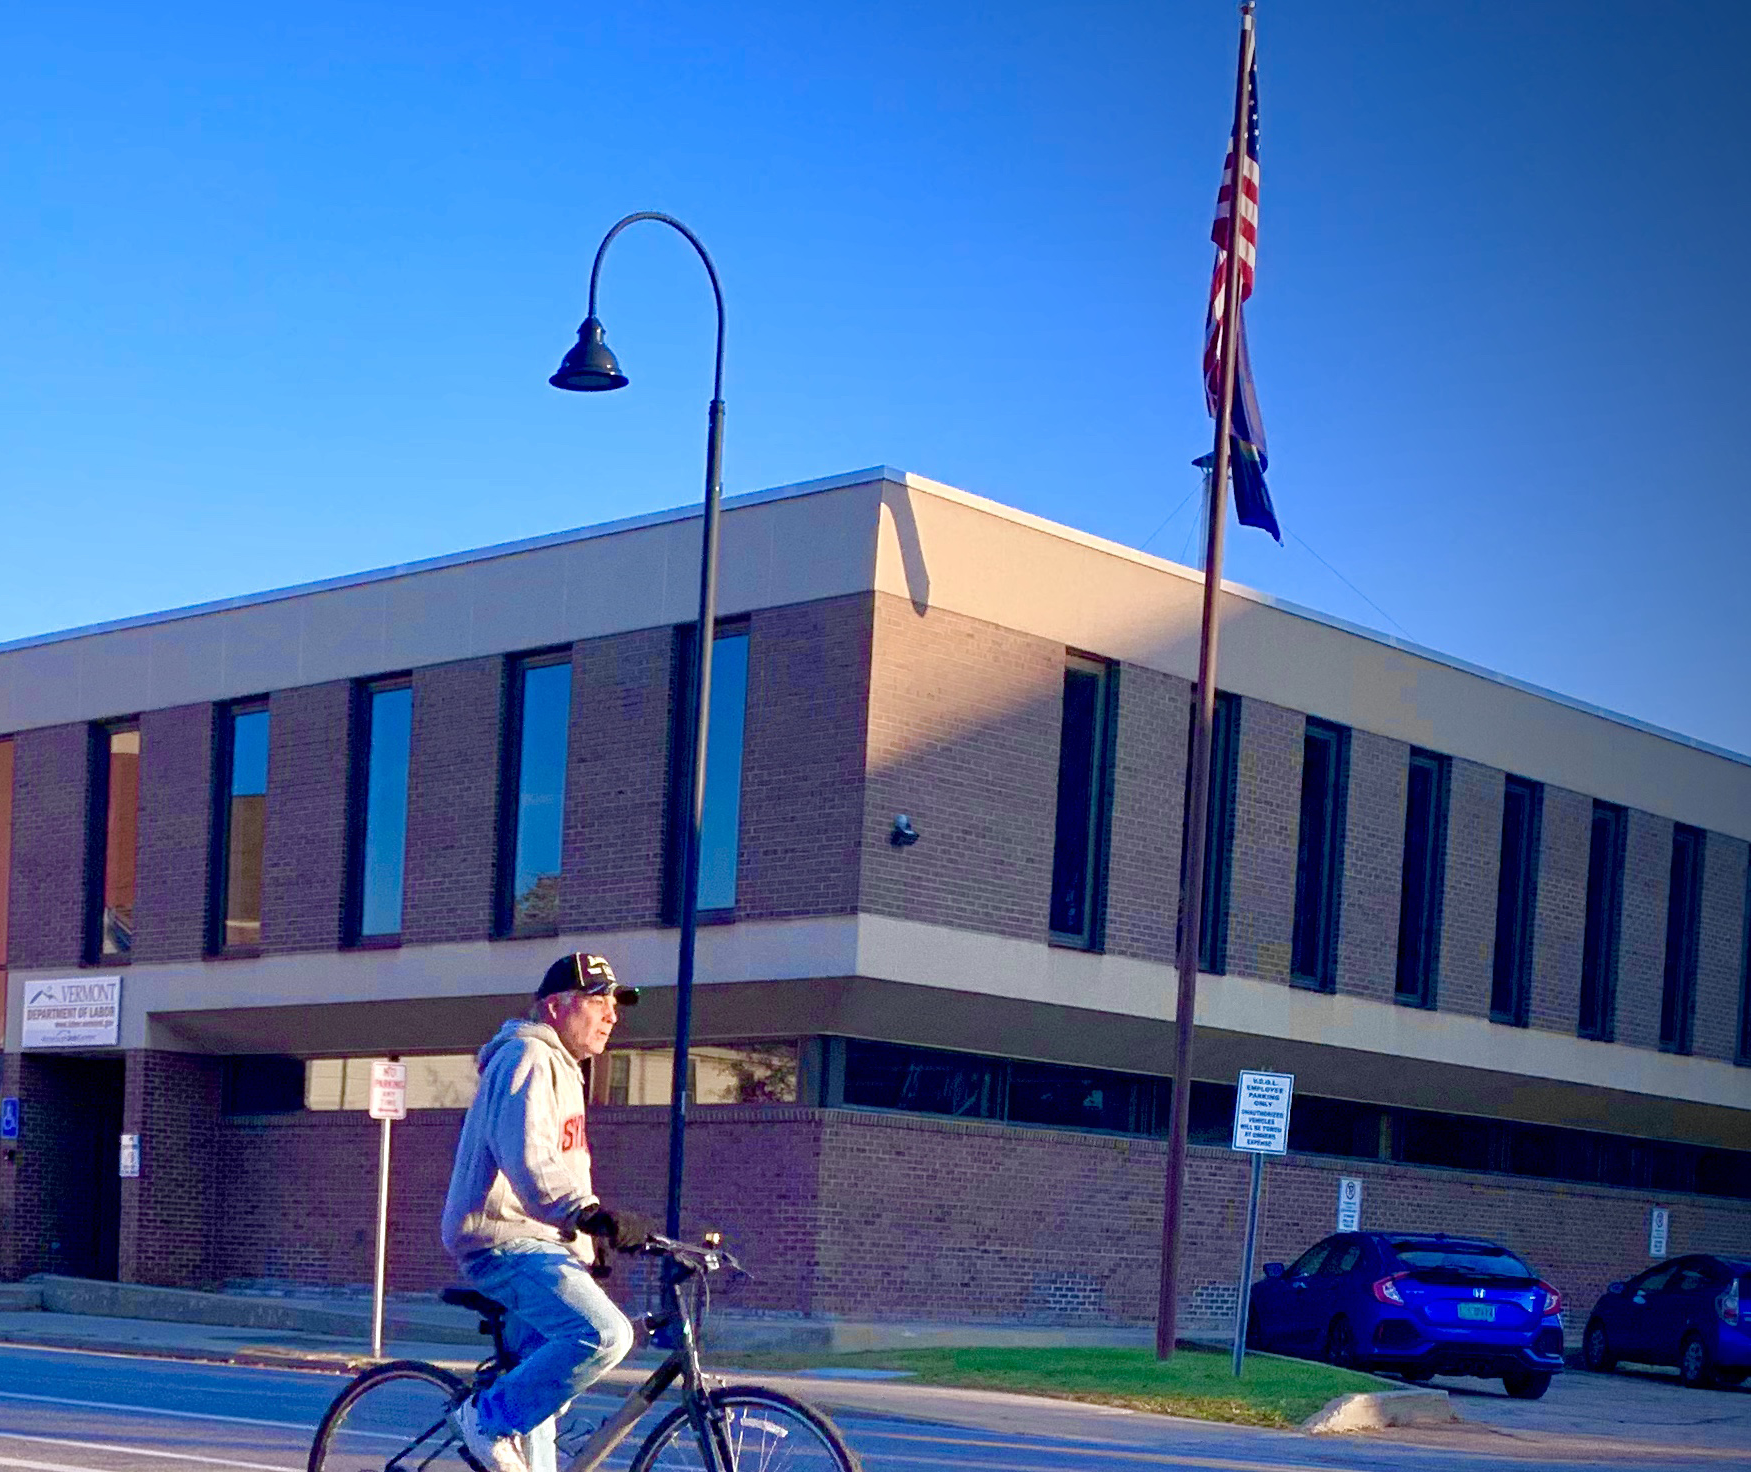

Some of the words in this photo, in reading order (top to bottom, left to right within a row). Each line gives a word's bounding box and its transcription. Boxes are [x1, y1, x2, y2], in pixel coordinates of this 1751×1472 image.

[61, 983, 116, 1003] VERMONT
[27, 1007, 77, 1021] DEPARTMENT
[77, 1007, 88, 1019] OF
[89, 1006, 116, 1019] LABOR
[383, 1067, 397, 1078] NO
[375, 1079, 406, 1089] PARKING
[1247, 1085, 1284, 1094] EMPLOYEE
[1249, 1092, 1280, 1101] PARKING
[1241, 1109, 1284, 1118] UNAUTHORIZED
[1248, 1117, 1275, 1125] VEHICLES
[1240, 1123, 1253, 1131] WILL
[1254, 1124, 1261, 1132] BE
[1262, 1125, 1282, 1133] TOWED
